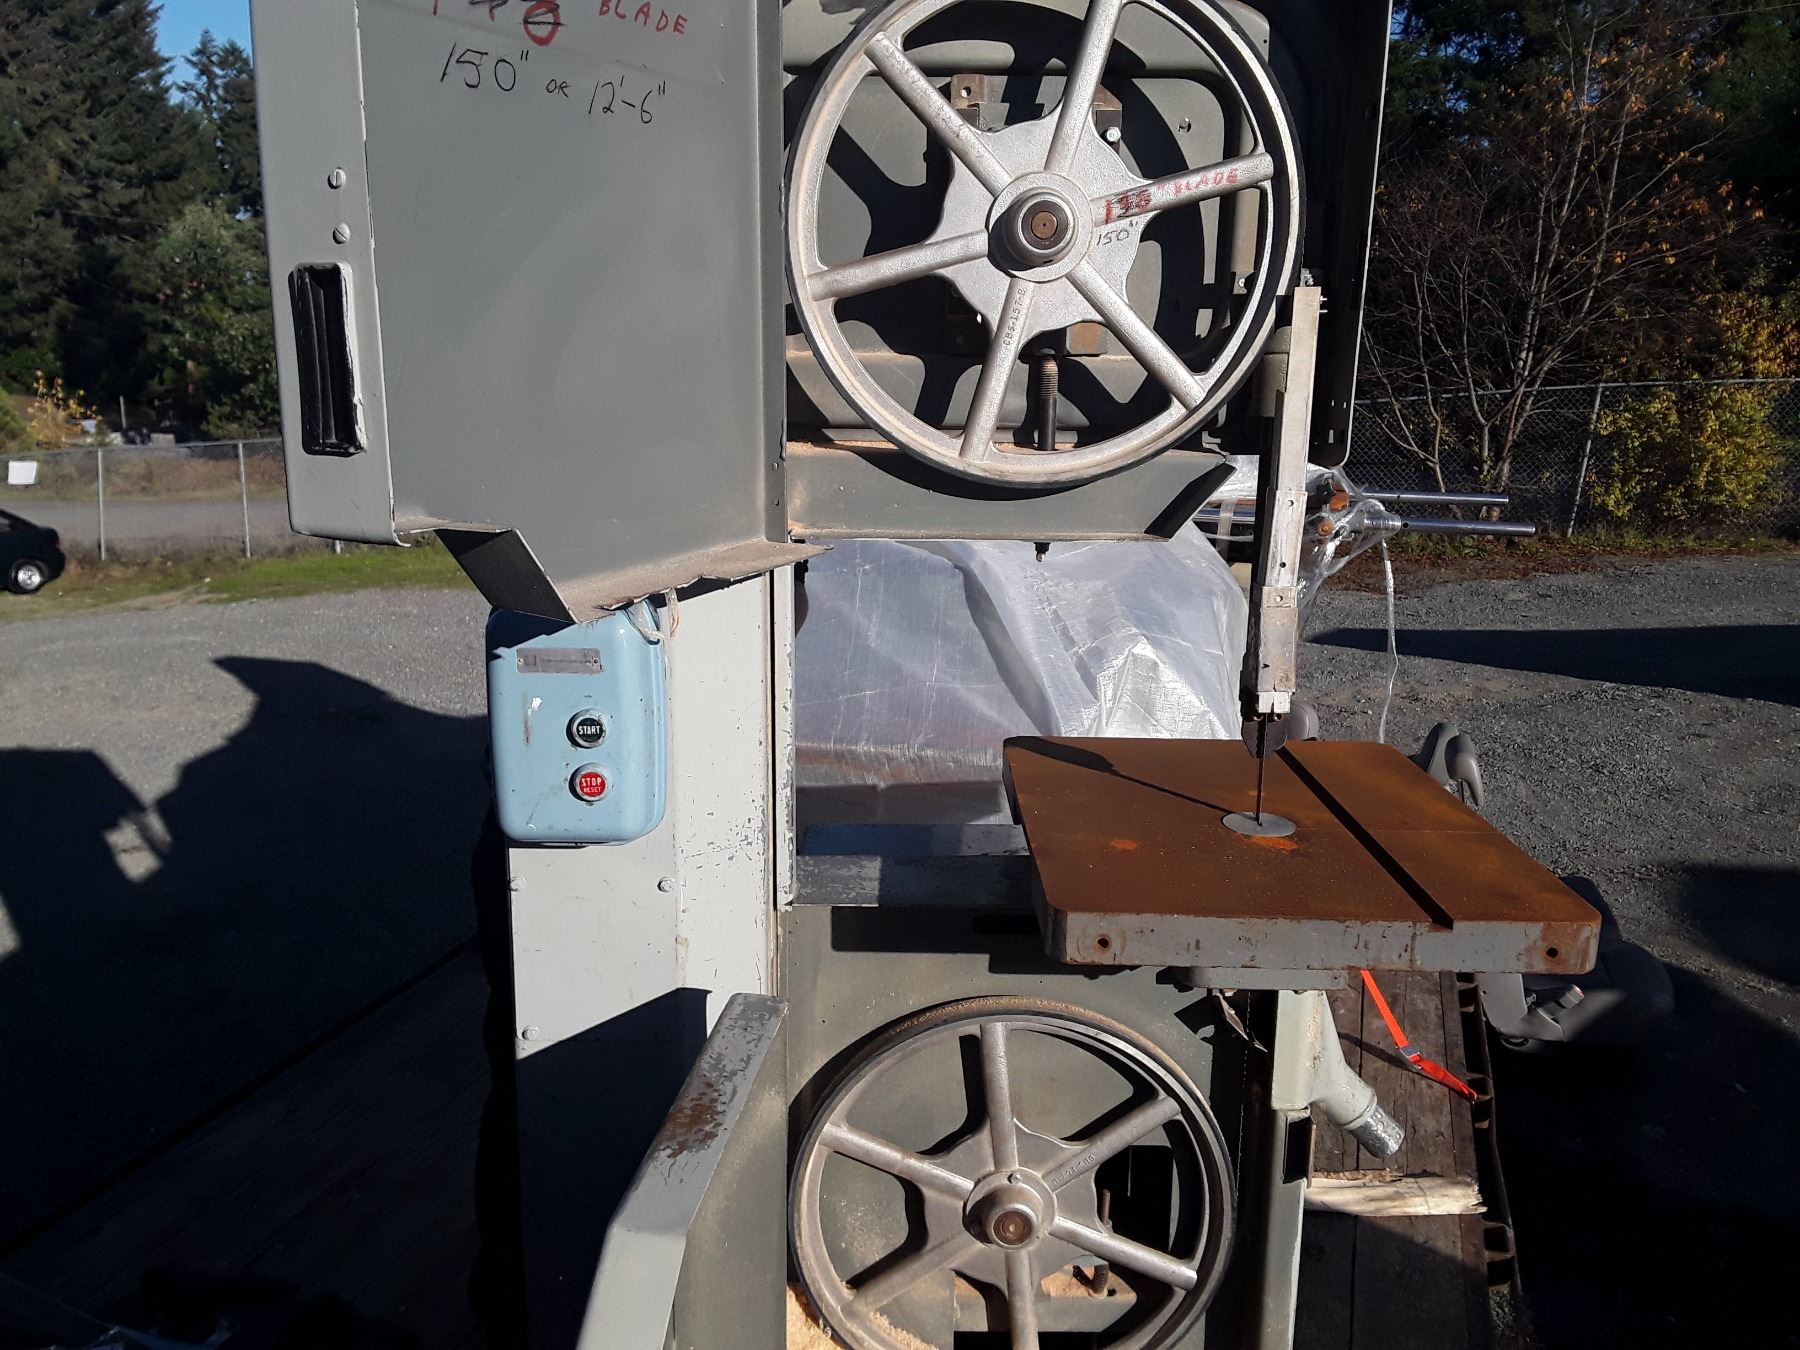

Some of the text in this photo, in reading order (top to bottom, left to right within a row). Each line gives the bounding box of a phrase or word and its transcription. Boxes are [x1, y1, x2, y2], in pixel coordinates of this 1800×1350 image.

[598, 0, 688, 35] BLADE
[440, 42, 529, 92] 150"
[546, 78, 569, 98] OR
[578, 725, 601, 735] START
[581, 777, 602, 787] STOP
